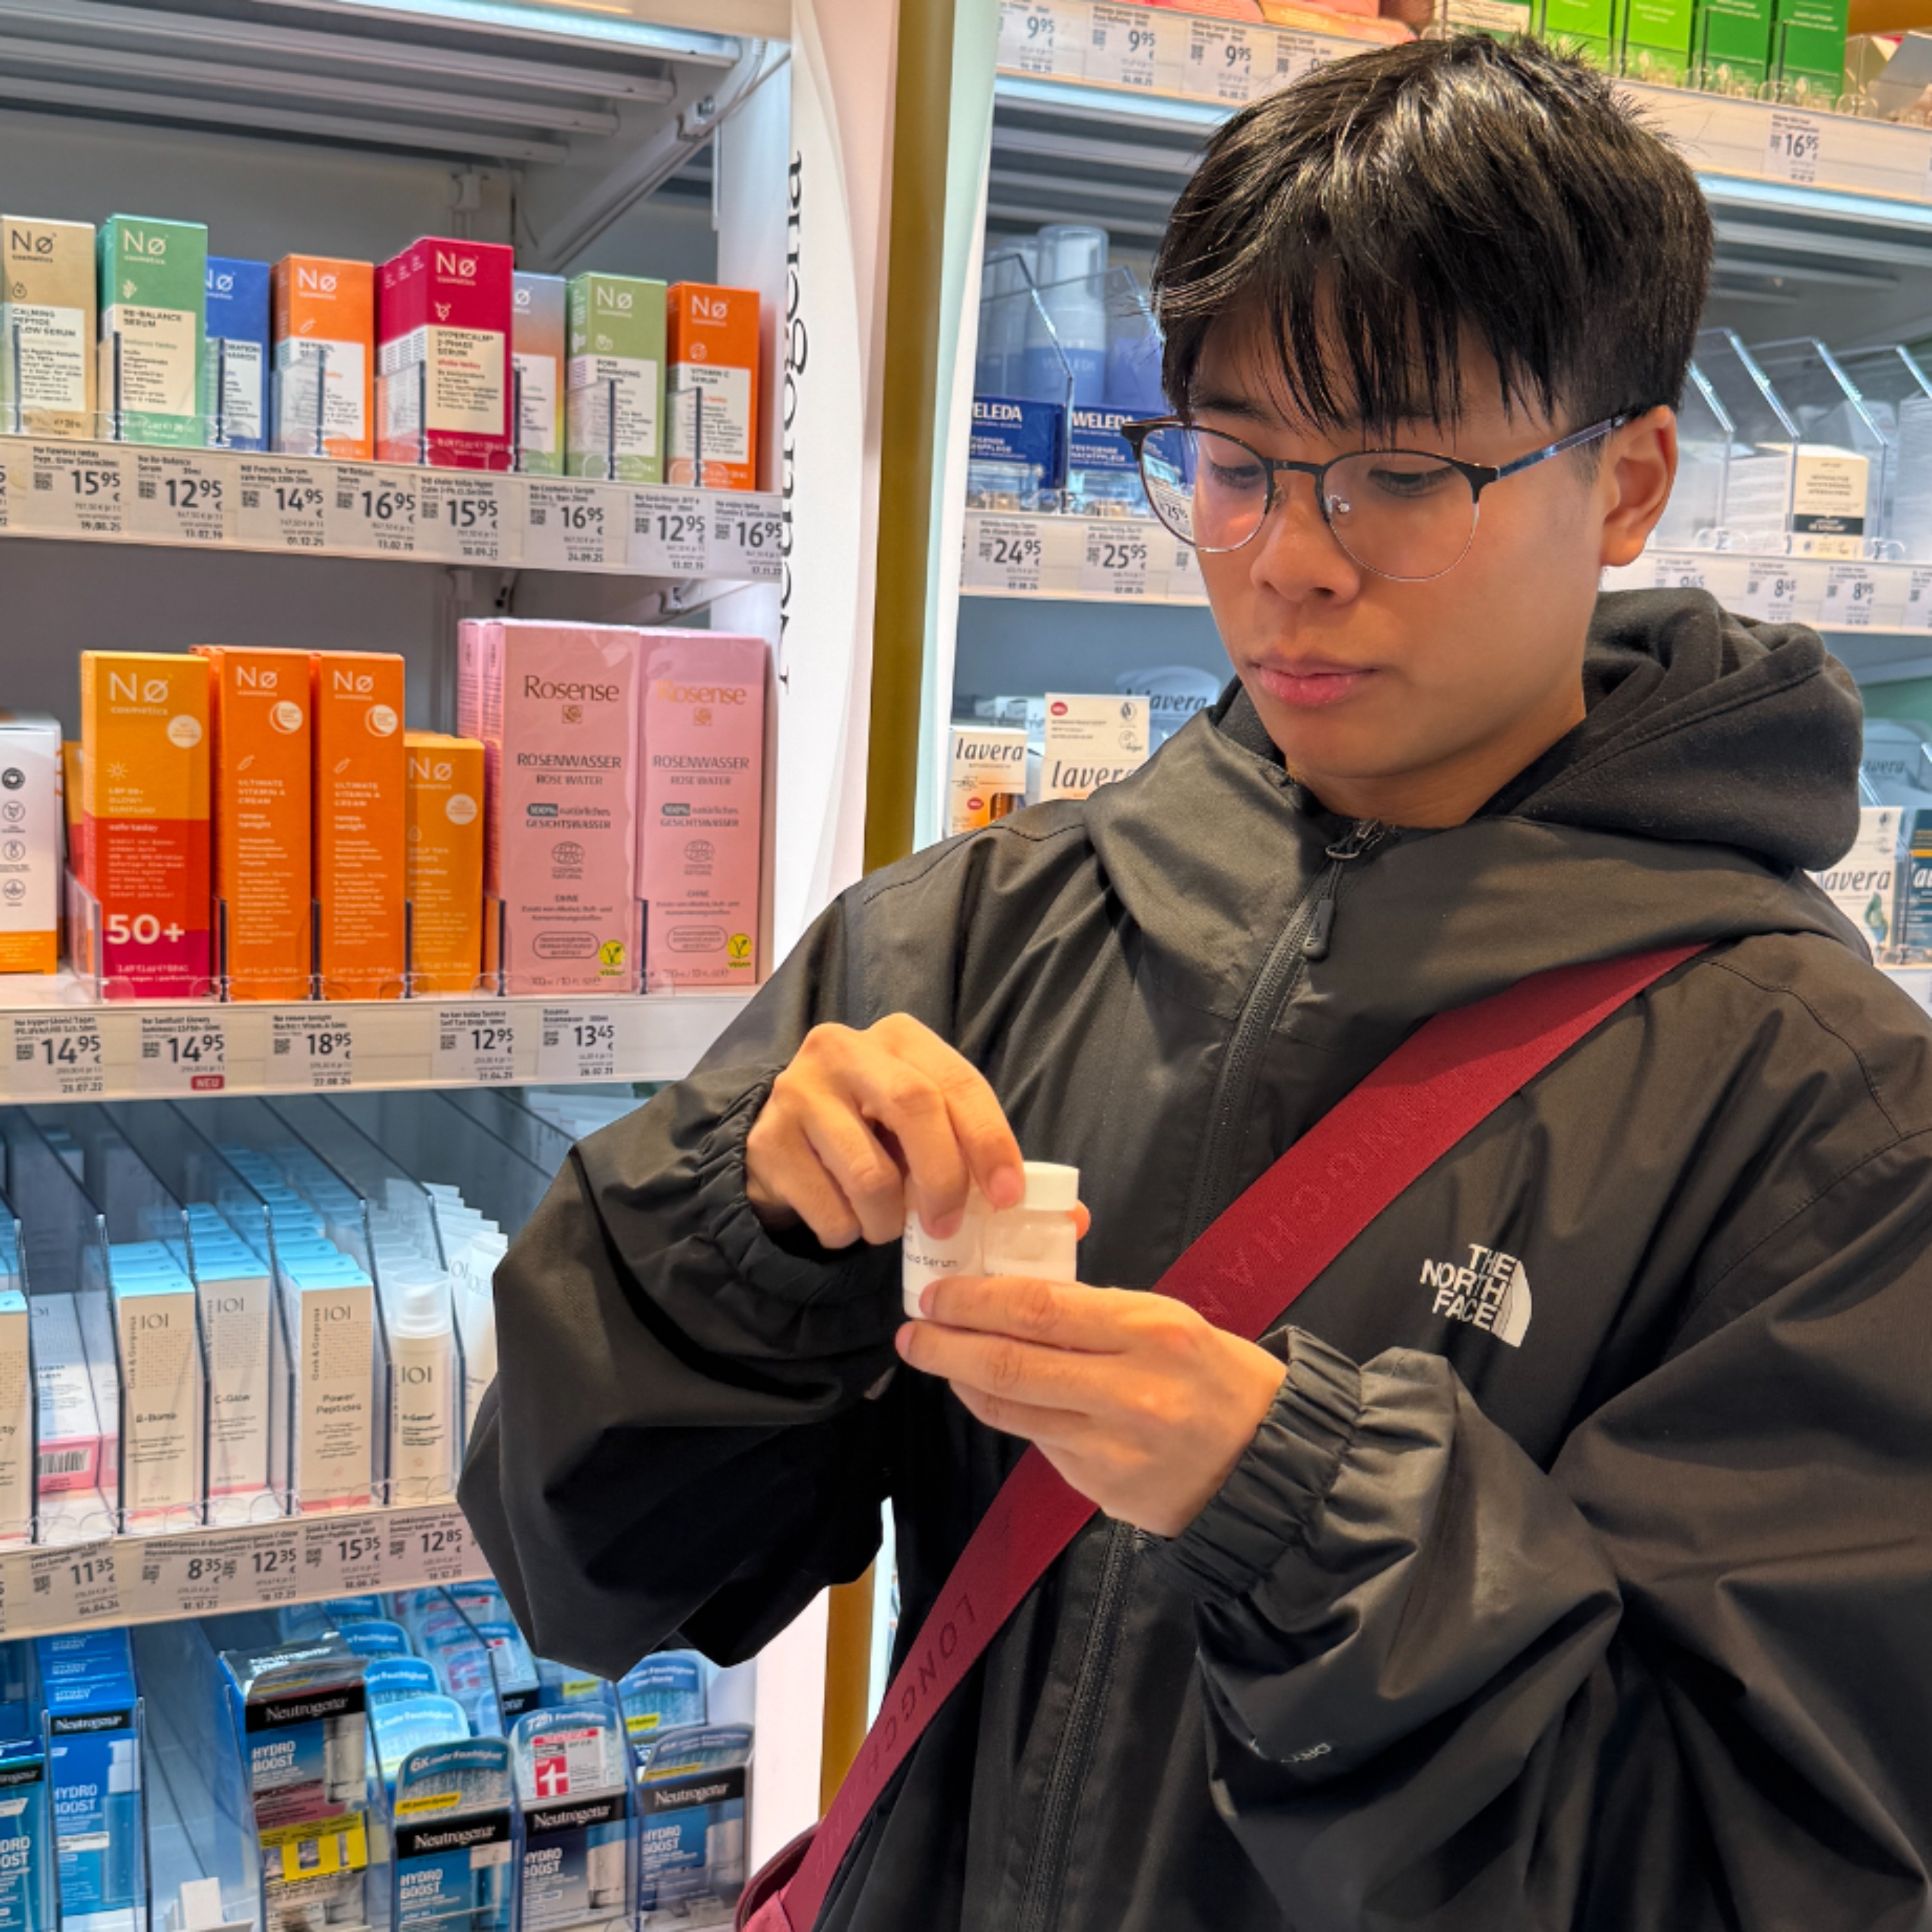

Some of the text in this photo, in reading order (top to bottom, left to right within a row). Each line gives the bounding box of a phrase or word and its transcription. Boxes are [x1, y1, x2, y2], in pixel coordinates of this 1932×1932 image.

[524, 675, 620, 702] Rosense
[657, 681, 746, 706] Rosense
[111, 706, 169, 716] cosmetics
[956, 737, 1024, 762] lavera
[517, 753, 621, 769] ROSENWASSER
[652, 755, 750, 770] ROSENWASSER
[536, 774, 603, 786] ROSE WATER
[670, 775, 732, 786] ROSE WATER
[526, 819, 611, 829] GESICHTSWASSER
[660, 818, 739, 828] GESICHTSWASSER
[106, 914, 185, 945] 50+
[196, 1079, 219, 1088] NEU
[922, 1256, 959, 1268] Serum
[1468, 1243, 1517, 1282] THE
[1419, 1258, 1508, 1306] NORTH
[1432, 1289, 1498, 1331] FACE
[323, 1393, 355, 1402] Power
[316, 1403, 362, 1414] Peptides
[265, 1698, 348, 1722] Neutrogena
[251, 1741, 296, 1759] HYDRO
[251, 1754, 294, 1774] BOOST
[654, 1782, 730, 1806] Neutrogena
[534, 1804, 611, 1829] Neutrogena
[414, 1824, 496, 1850] Neutrogena
[643, 1825, 682, 1842] HYDRO
[643, 1837, 679, 1854] BOOST
[401, 1869, 442, 1887] HYDRO
[401, 1882, 441, 1900] BOOST
